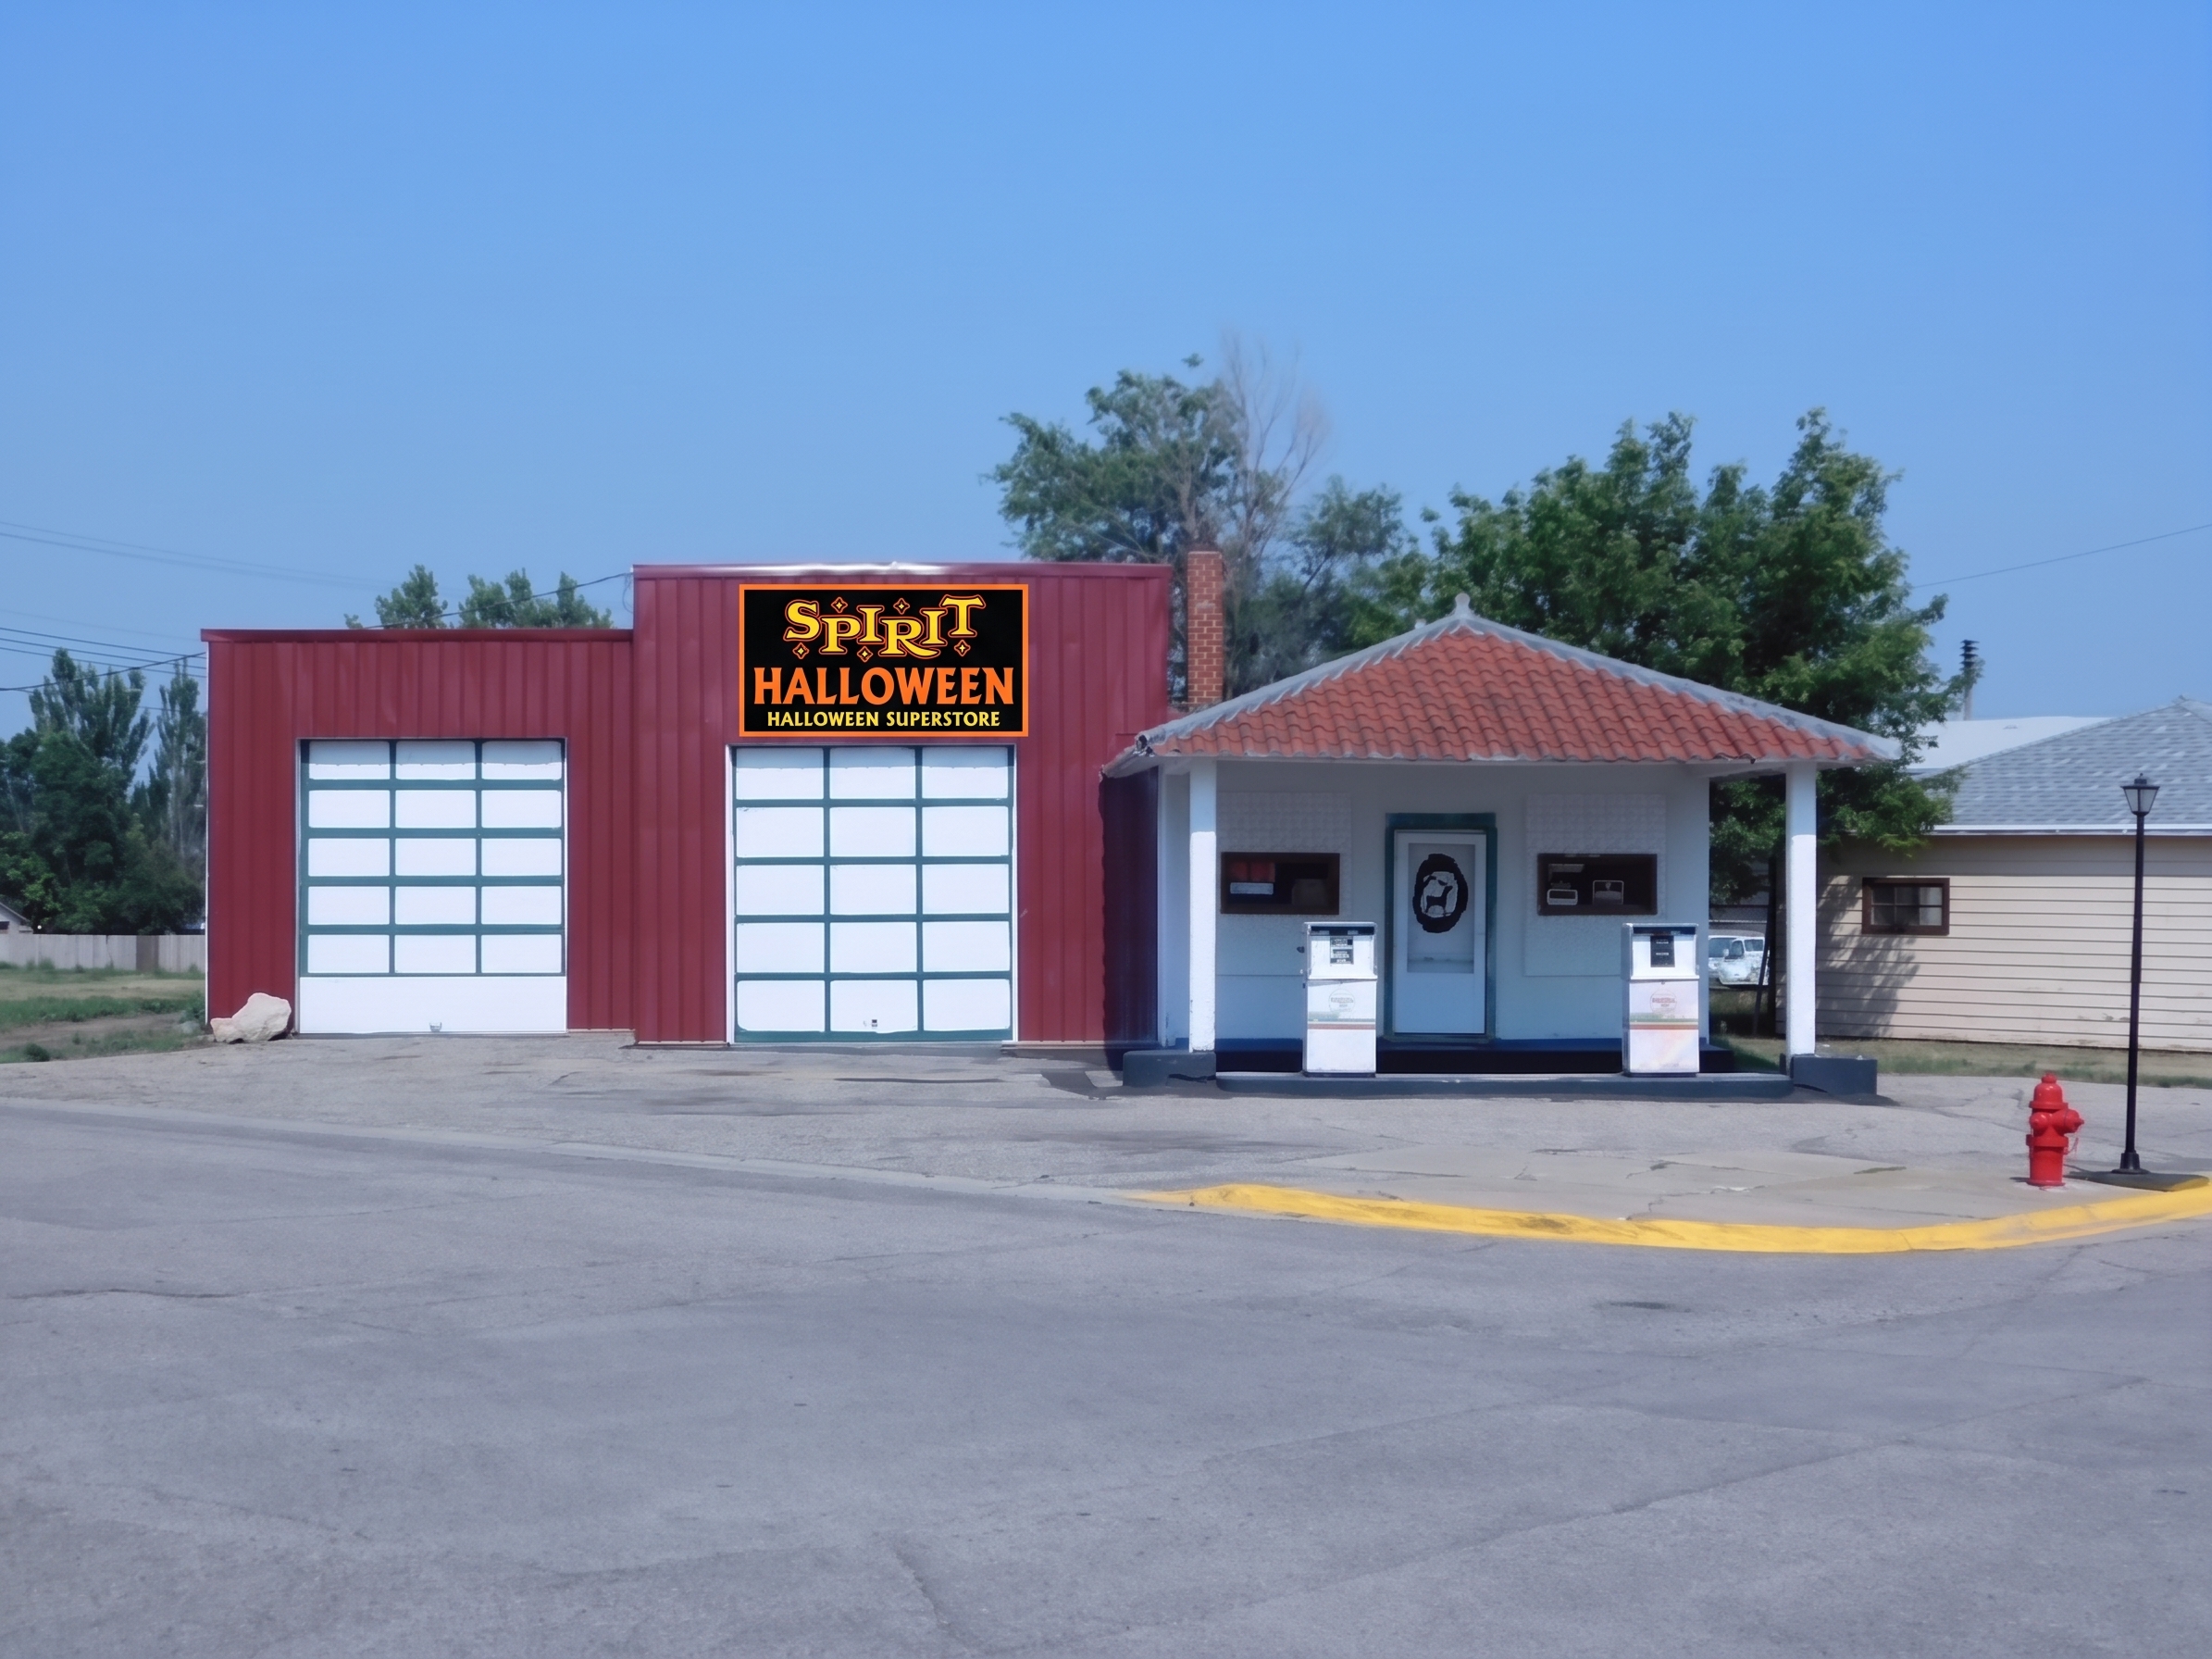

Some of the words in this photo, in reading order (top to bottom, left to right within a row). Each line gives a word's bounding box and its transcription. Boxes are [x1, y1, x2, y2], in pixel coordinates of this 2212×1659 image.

[784, 594, 986, 658] SPIRIT
[753, 667, 1014, 705] HALLOWEEN
[767, 711, 879, 727] HALLOWEEN
[886, 711, 1000, 727] SUPERSTORE
